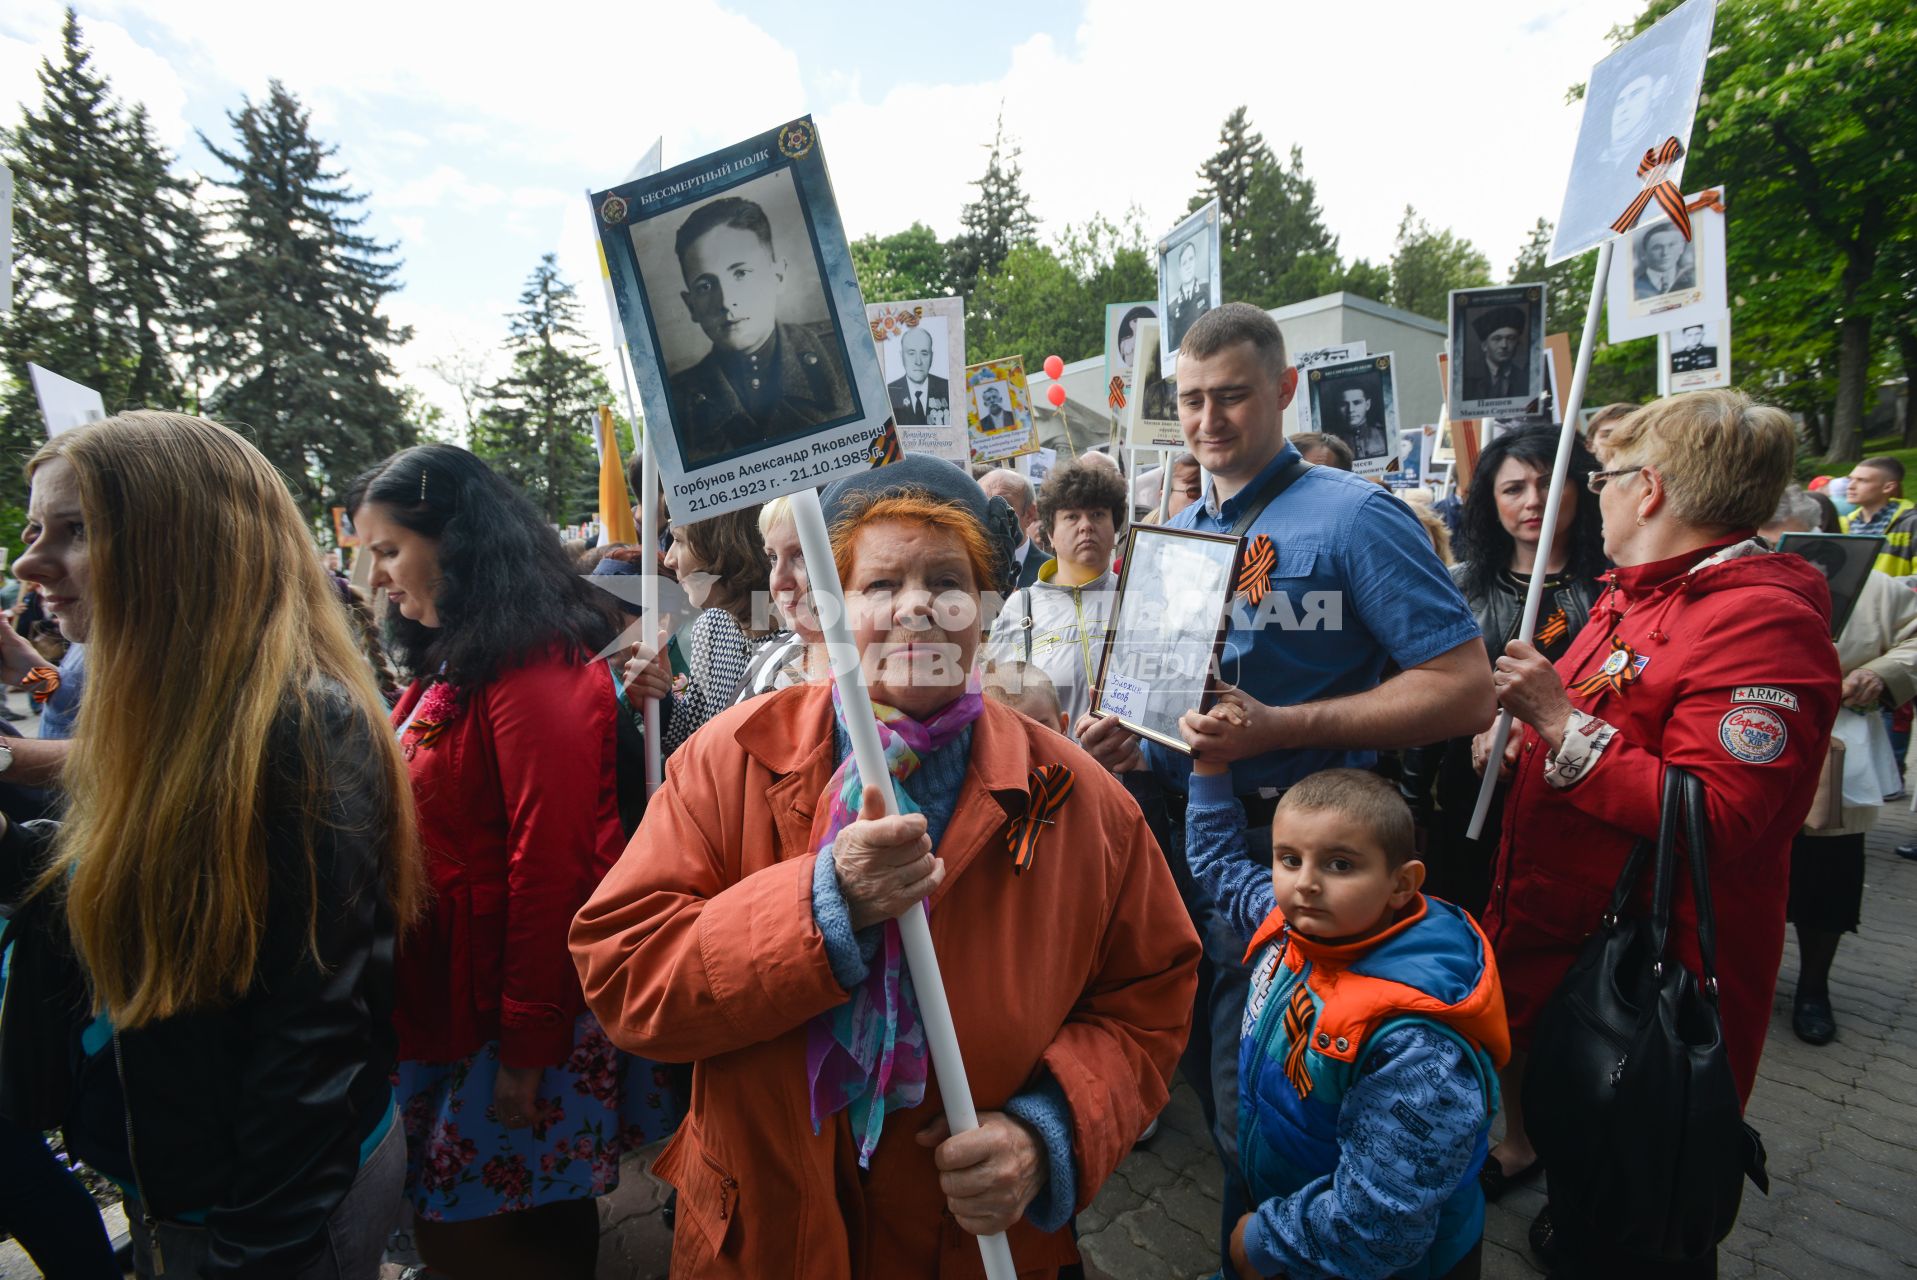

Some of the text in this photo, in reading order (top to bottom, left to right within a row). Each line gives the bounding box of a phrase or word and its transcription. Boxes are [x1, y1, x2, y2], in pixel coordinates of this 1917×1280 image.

[640, 149, 770, 205] БЕССМЕРТНЫЙ ПОЛК
[673, 425, 887, 497] Горбунов Александр Яковлевич
[688, 479, 767, 513] 21.06.1923
[770, 477, 780, 488] г.
[790, 448, 870, 483] 21.10.1985
[872, 447, 885, 459] г.
[1747, 687, 1786, 702] ARMY
